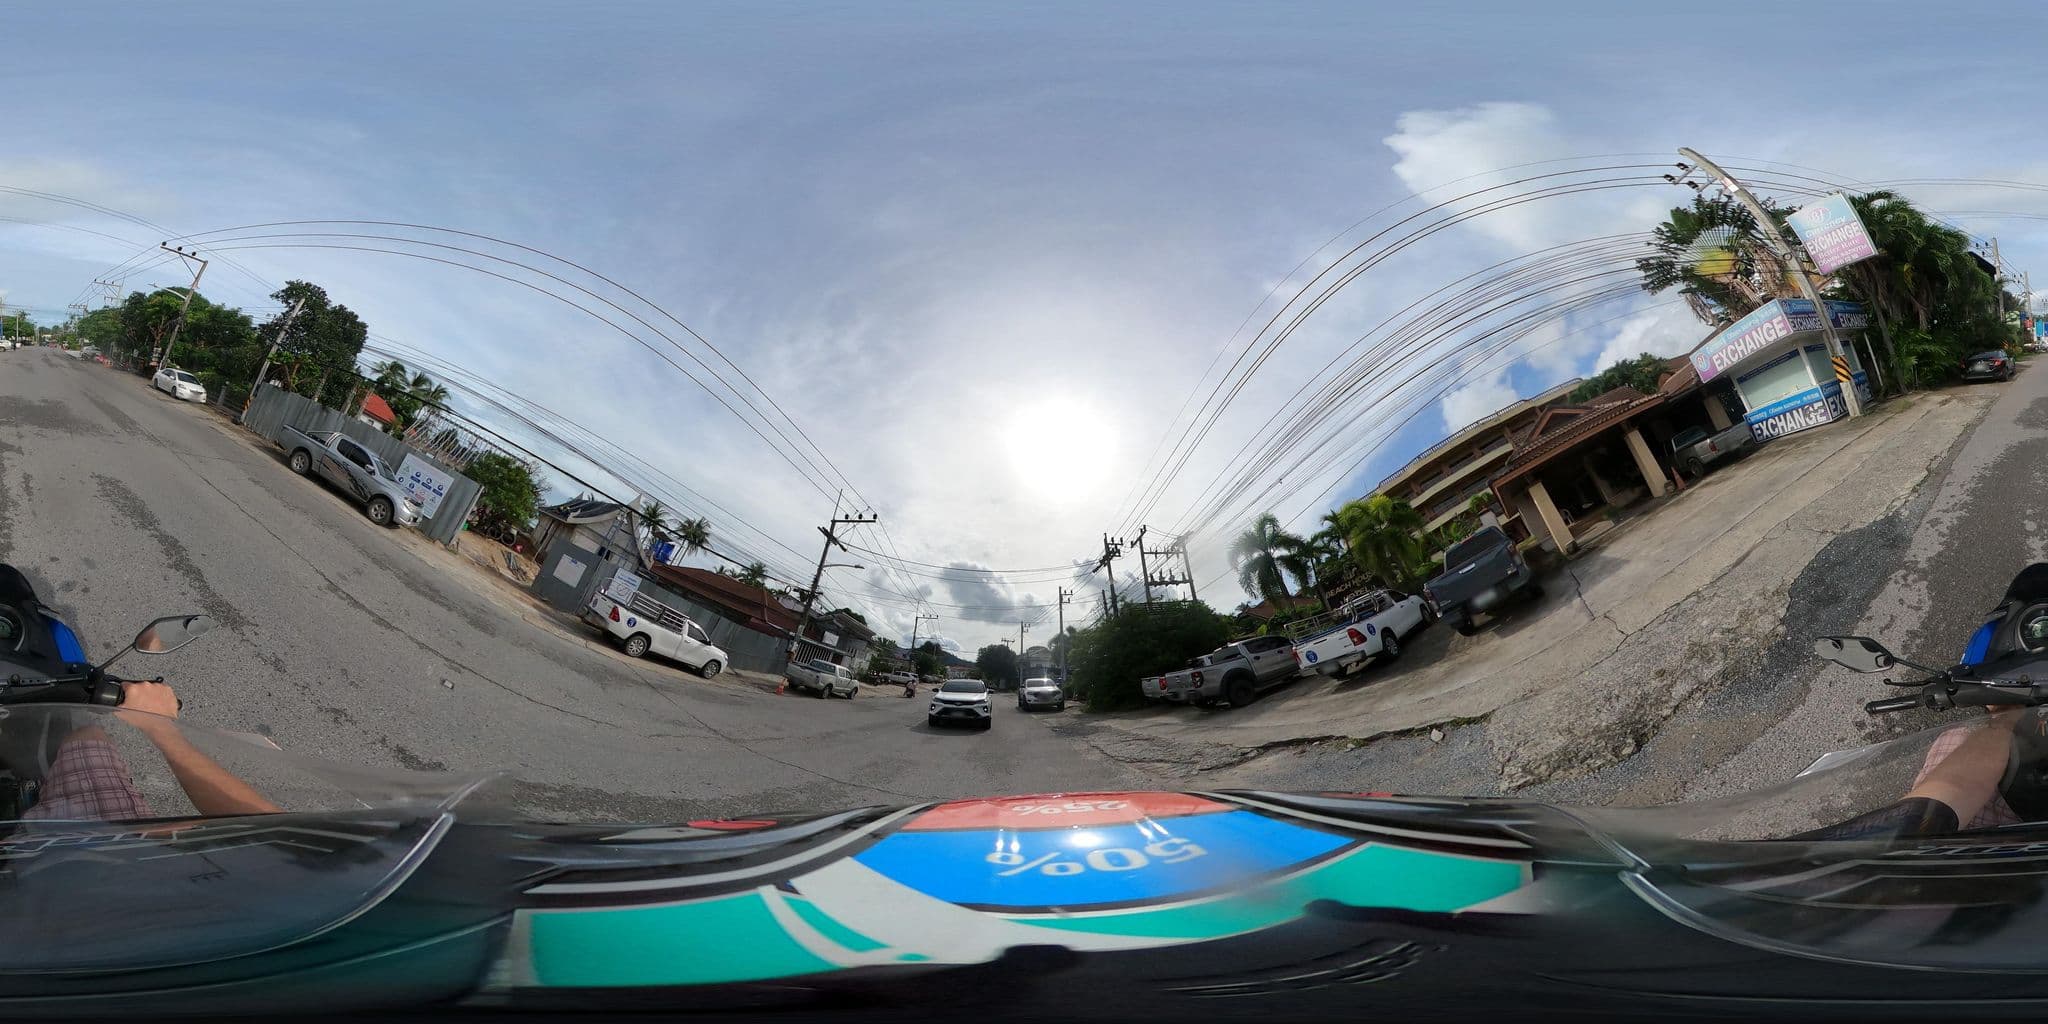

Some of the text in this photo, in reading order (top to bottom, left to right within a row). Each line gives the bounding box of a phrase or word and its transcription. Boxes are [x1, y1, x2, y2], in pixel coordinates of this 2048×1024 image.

[1805, 221, 1861, 255] EXCHANGE
[1789, 317, 1824, 330] EXCHANGE
[1711, 315, 1788, 371] EXCHANGE
[1751, 401, 1828, 441] EXCHANGE
[1011, 800, 1128, 816] 25%
[985, 837, 1209, 876] 50%
